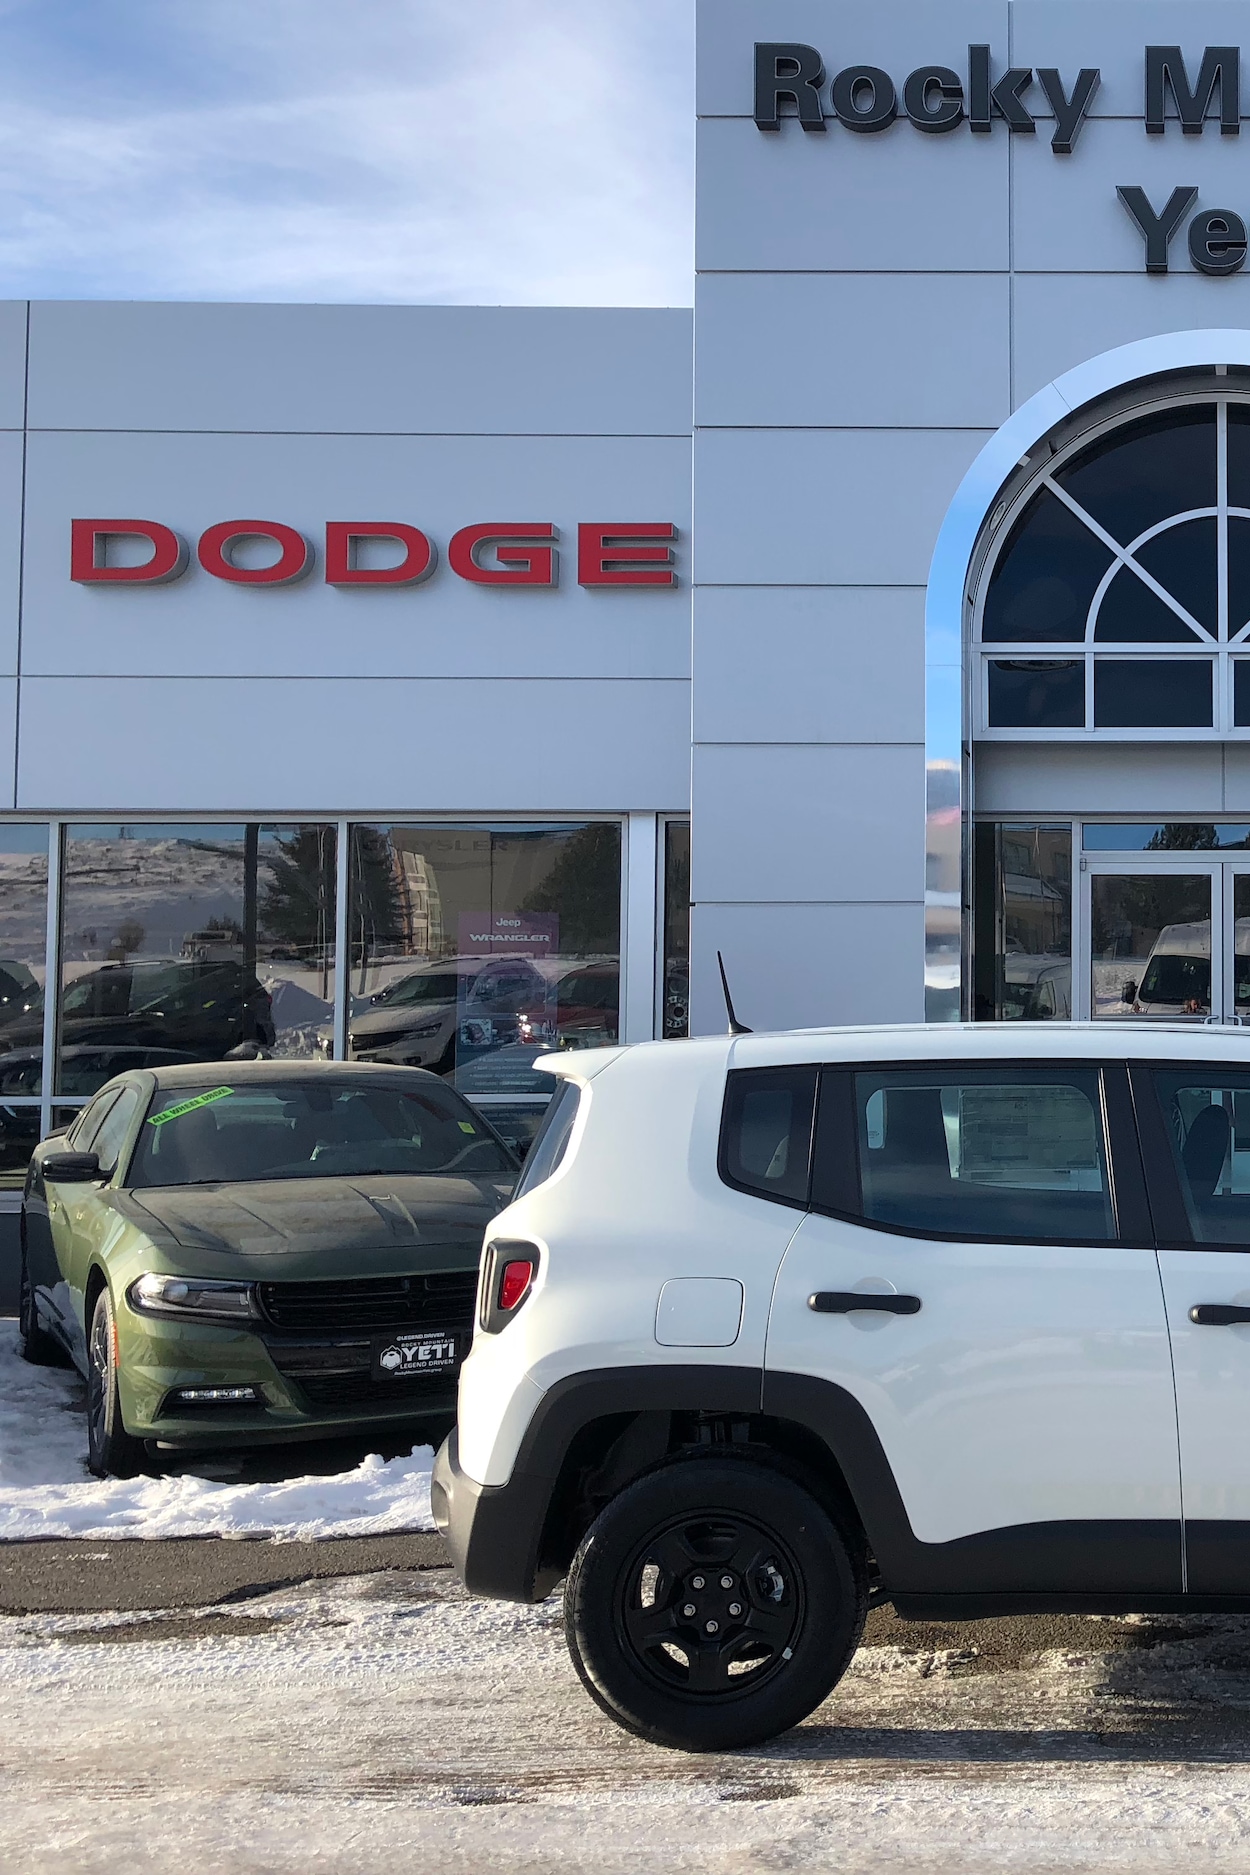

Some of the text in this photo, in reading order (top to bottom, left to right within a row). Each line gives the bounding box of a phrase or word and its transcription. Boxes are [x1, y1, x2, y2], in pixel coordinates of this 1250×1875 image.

[753, 42, 1100, 154] Rocky
[71, 518, 681, 590] DODGE
[495, 917, 521, 928] Jeep
[469, 933, 551, 942] WRANGLER
[169, 1098, 201, 1115] WHEEL
[201, 1087, 229, 1101] DRIVE
[401, 1342, 455, 1362] YETI
[400, 1358, 454, 1370] LEGEND DRIVEN
